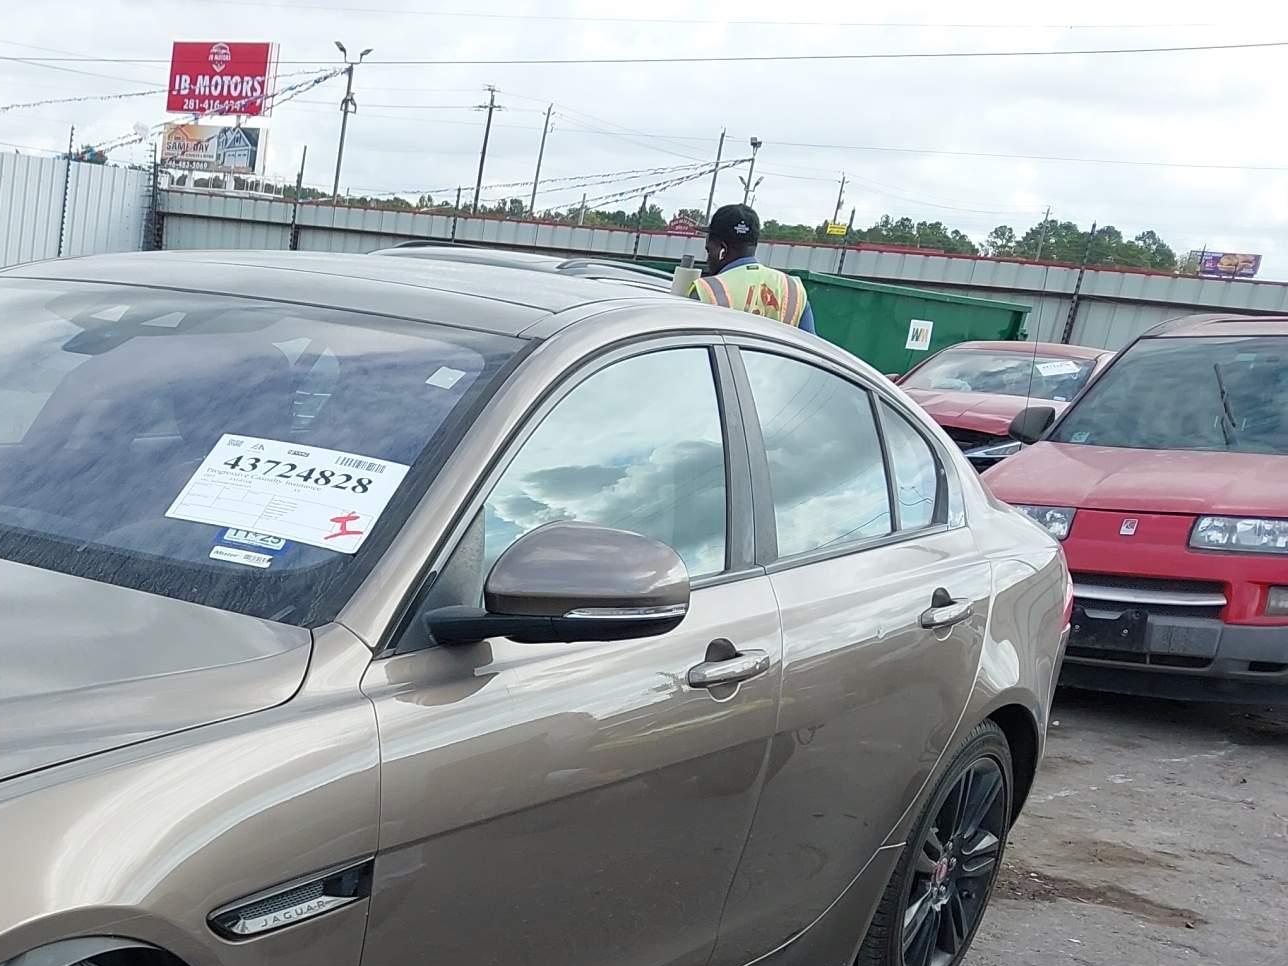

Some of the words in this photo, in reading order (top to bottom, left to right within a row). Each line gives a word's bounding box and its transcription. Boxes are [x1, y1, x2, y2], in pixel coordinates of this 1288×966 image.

[206, 467, 250, 479] Progressive
[223, 454, 374, 494] 43724828
[261, 900, 327, 928] JAGUAR
